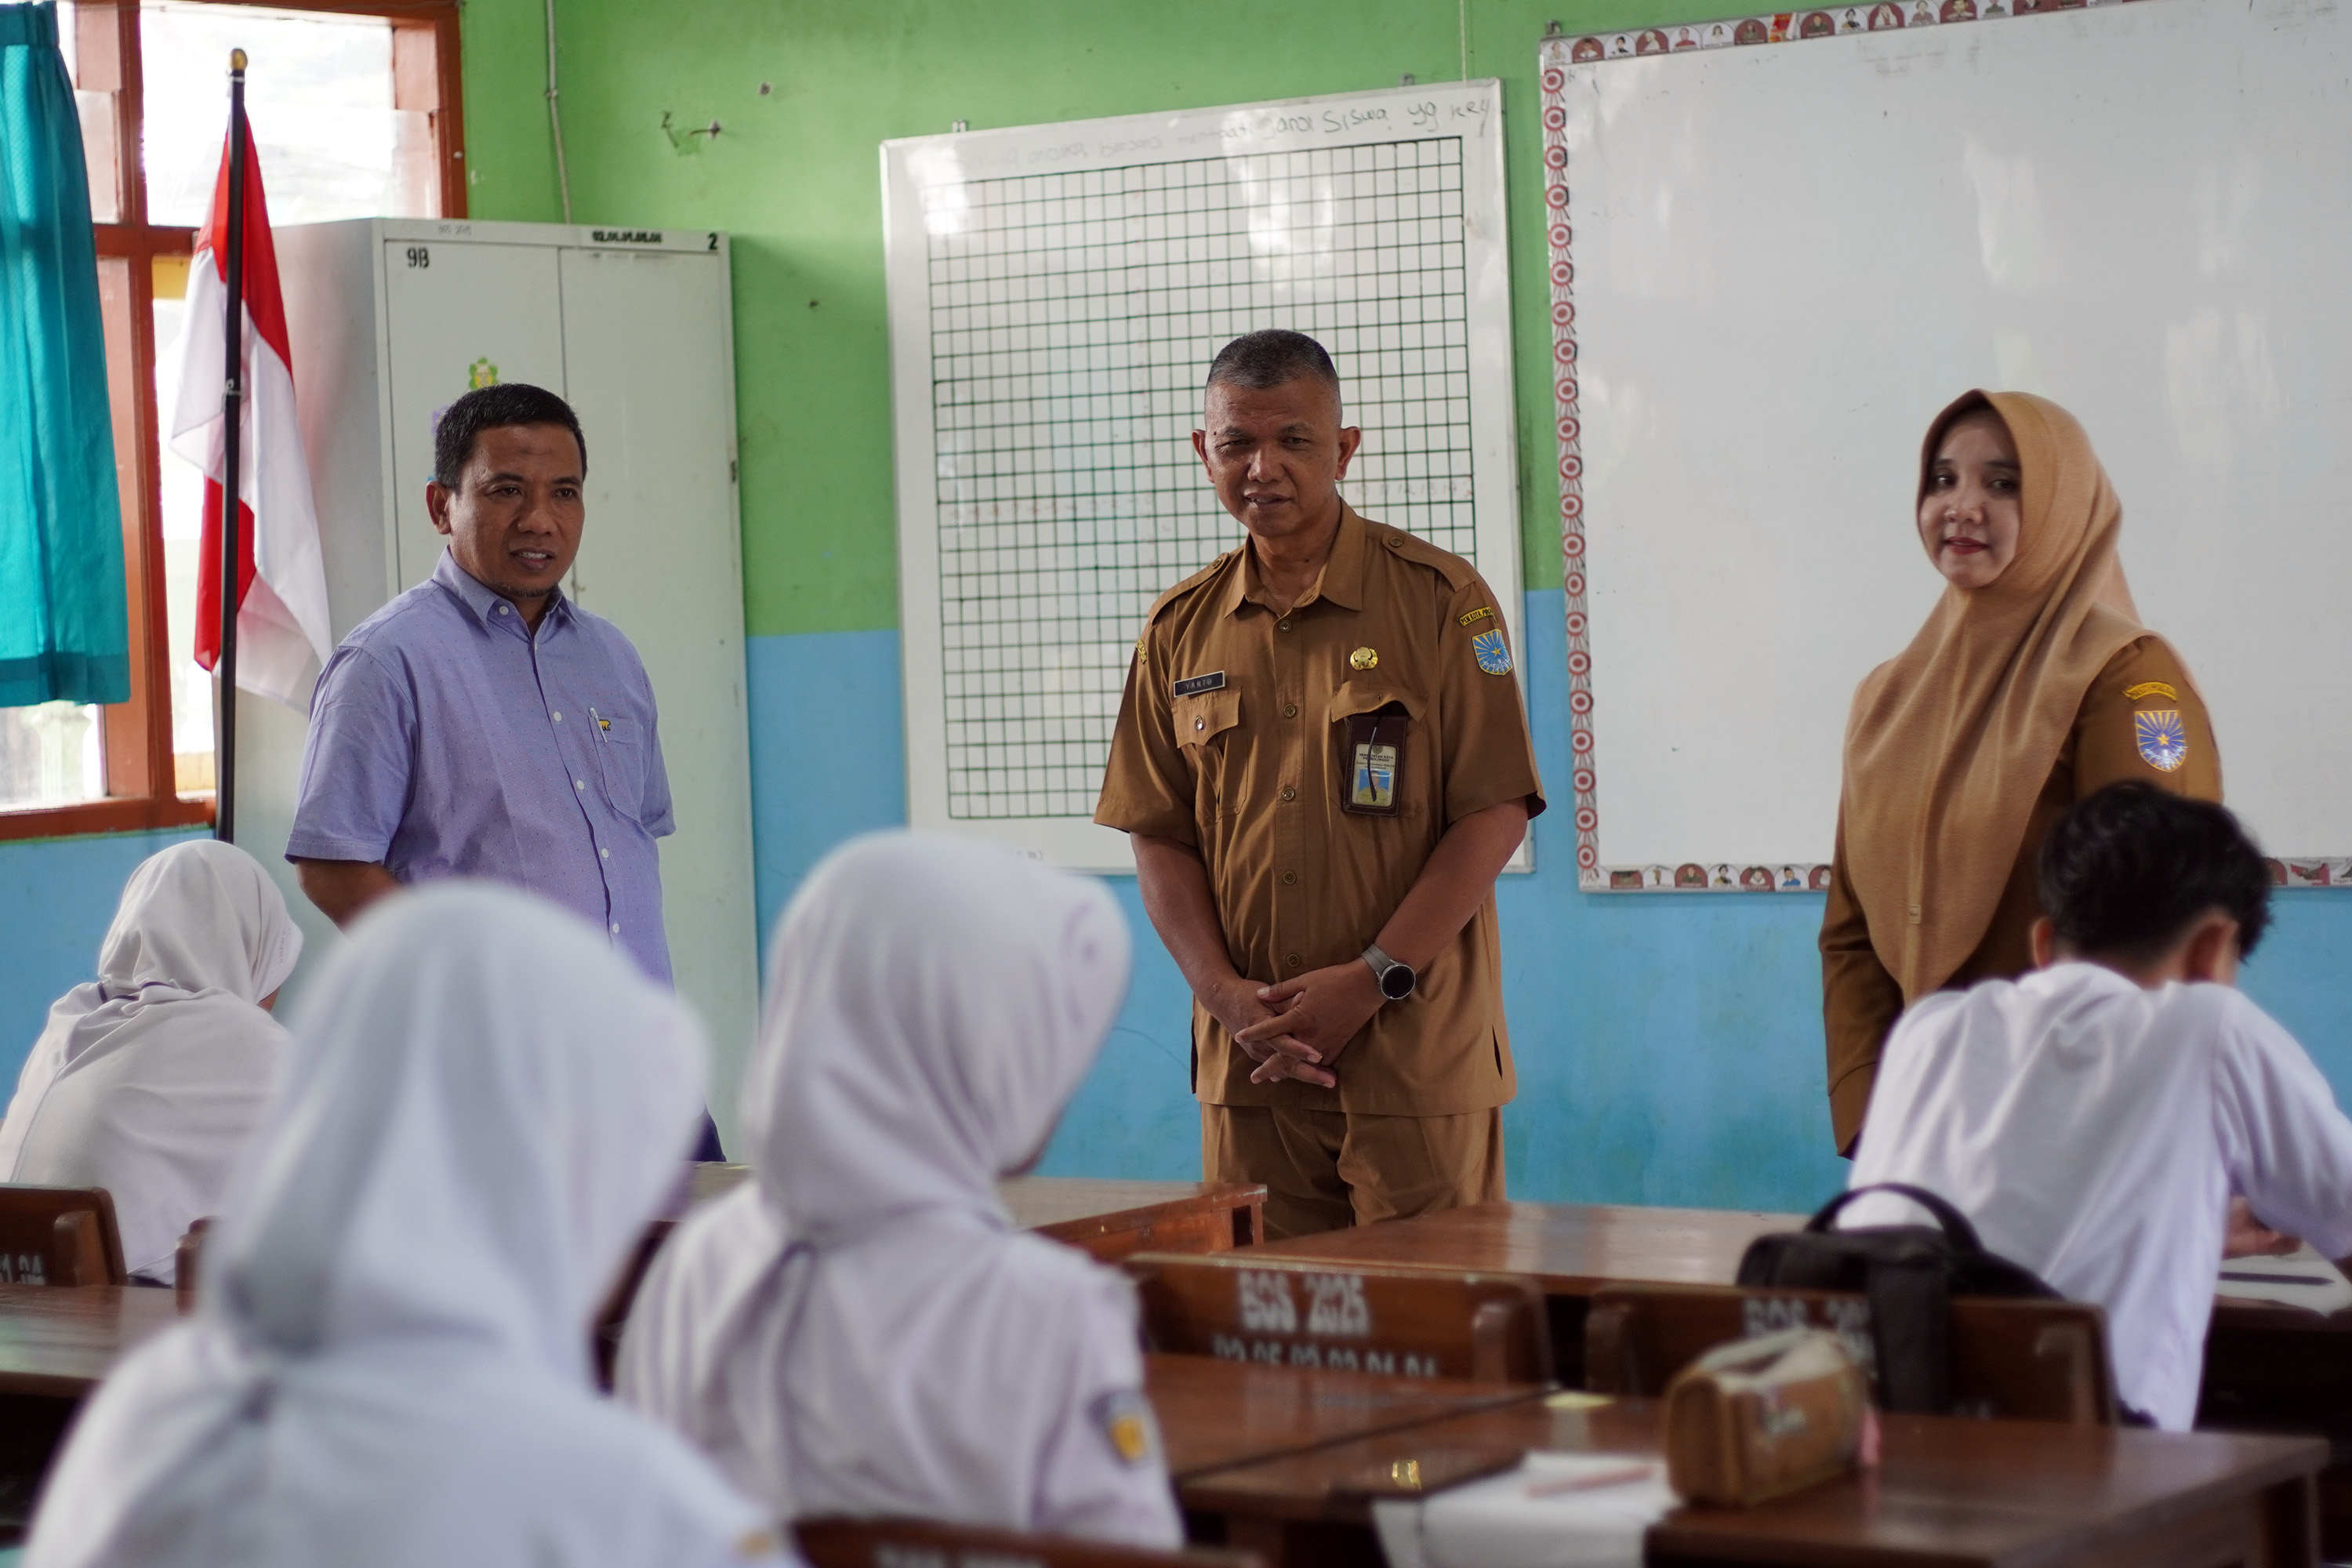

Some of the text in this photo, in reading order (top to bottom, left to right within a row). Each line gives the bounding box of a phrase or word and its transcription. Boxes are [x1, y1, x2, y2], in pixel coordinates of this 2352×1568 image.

[1408, 102, 1439, 132] yg
[708, 233, 717, 250] 2
[407, 247, 430, 268] 9B
